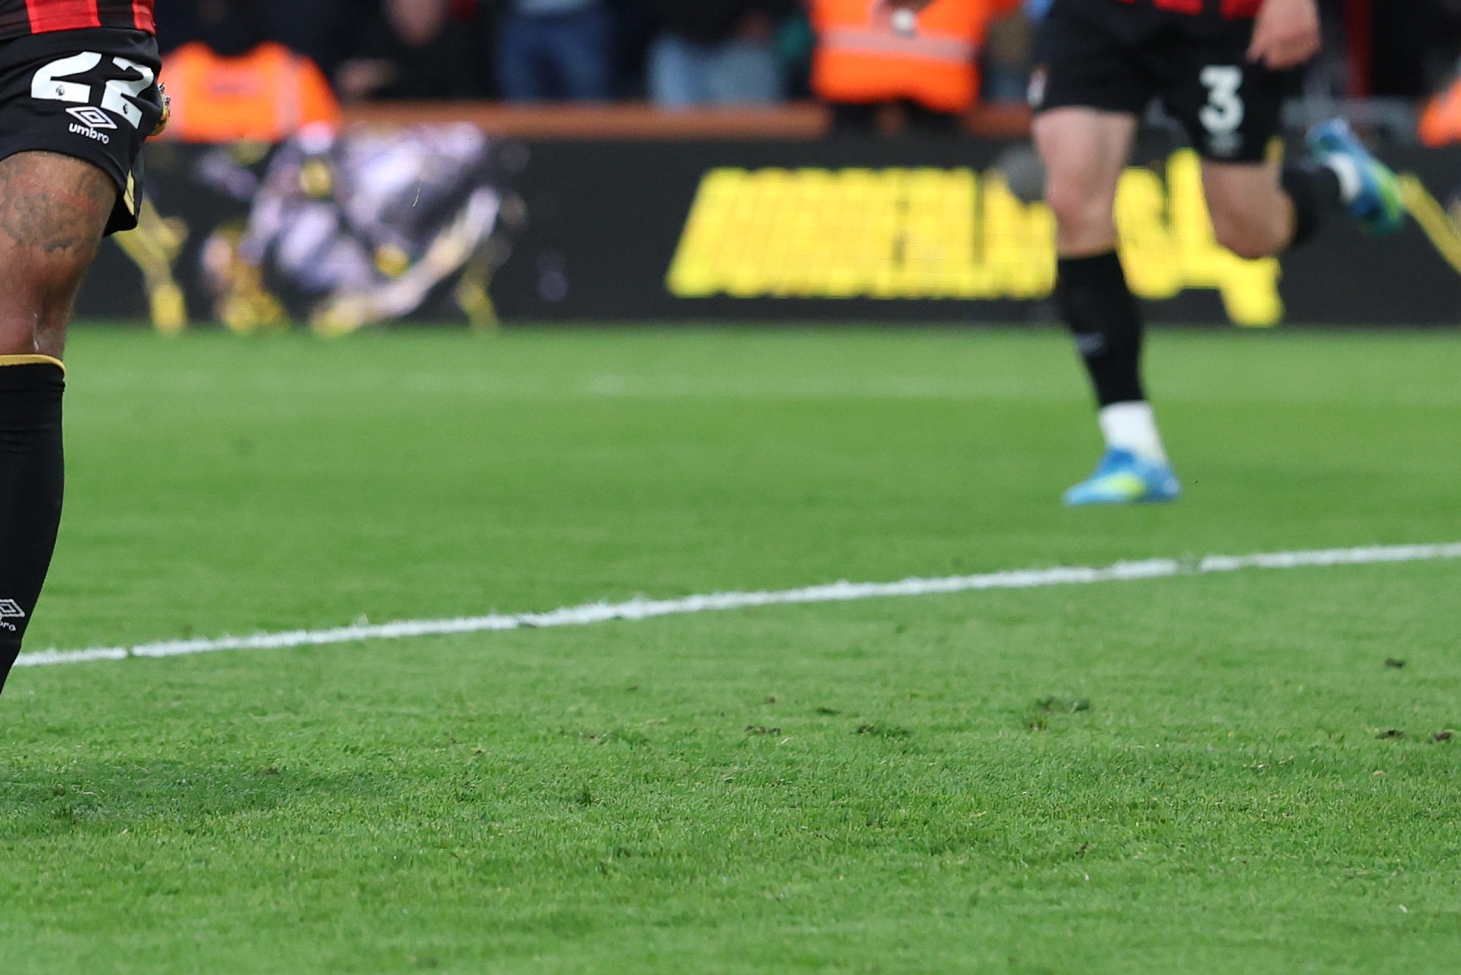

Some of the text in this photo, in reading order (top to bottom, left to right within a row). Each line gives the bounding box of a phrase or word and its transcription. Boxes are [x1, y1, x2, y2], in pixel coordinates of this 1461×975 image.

[31, 51, 154, 130] 22
[1198, 64, 1245, 133] 3
[68, 123, 110, 144] umbro
